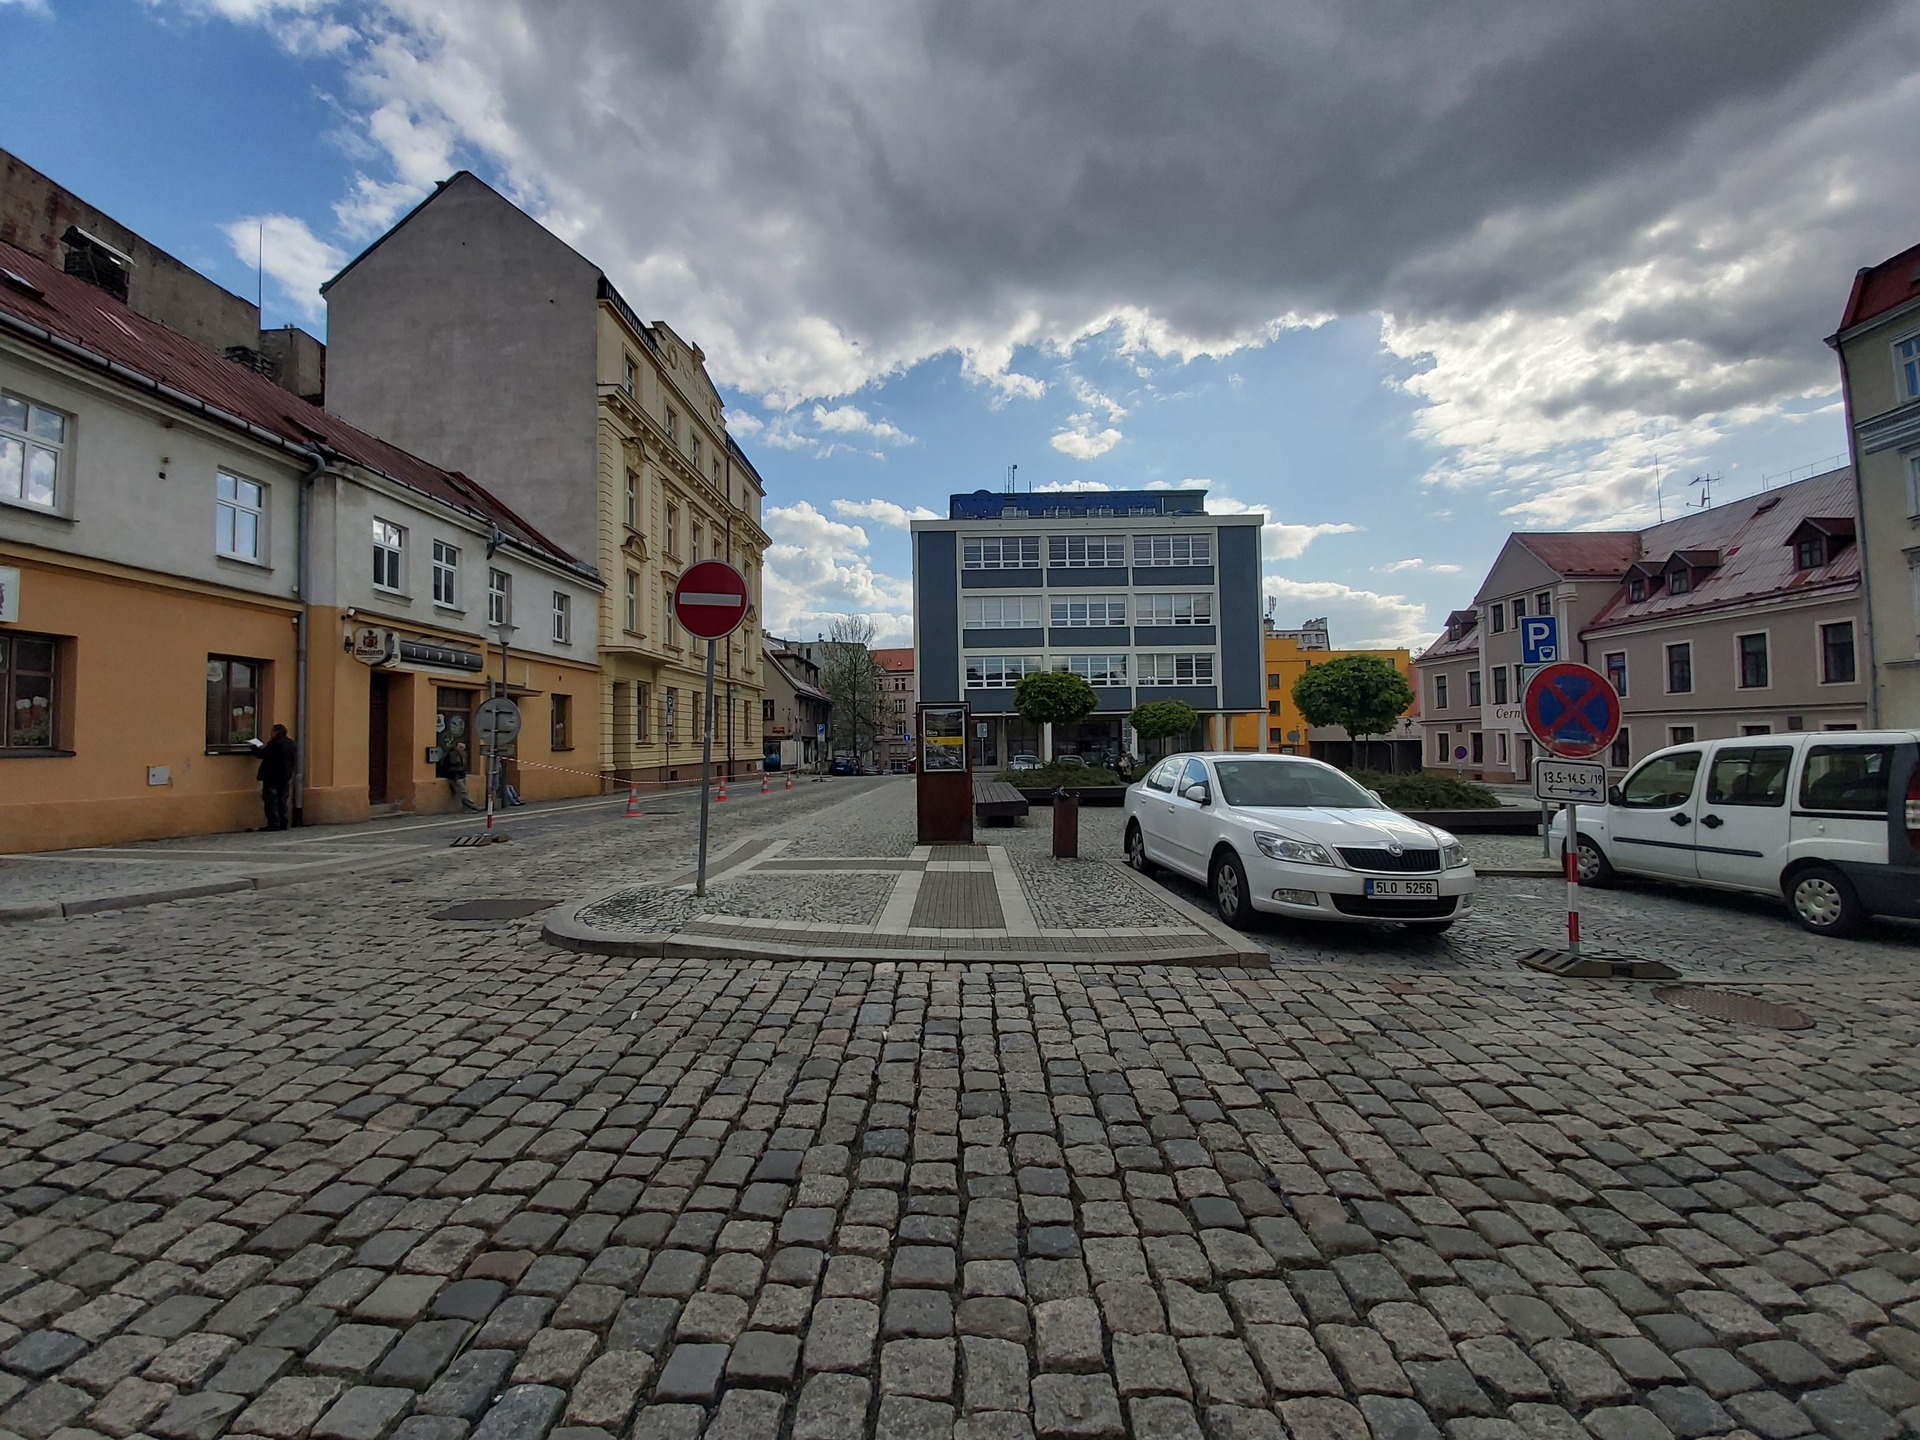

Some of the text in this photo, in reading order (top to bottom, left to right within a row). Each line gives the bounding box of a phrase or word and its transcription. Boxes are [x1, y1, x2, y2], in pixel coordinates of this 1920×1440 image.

[1528, 623, 1550, 651] P
[1495, 705, 1521, 719] Čern
[1405, 882, 1433, 894] 5256
